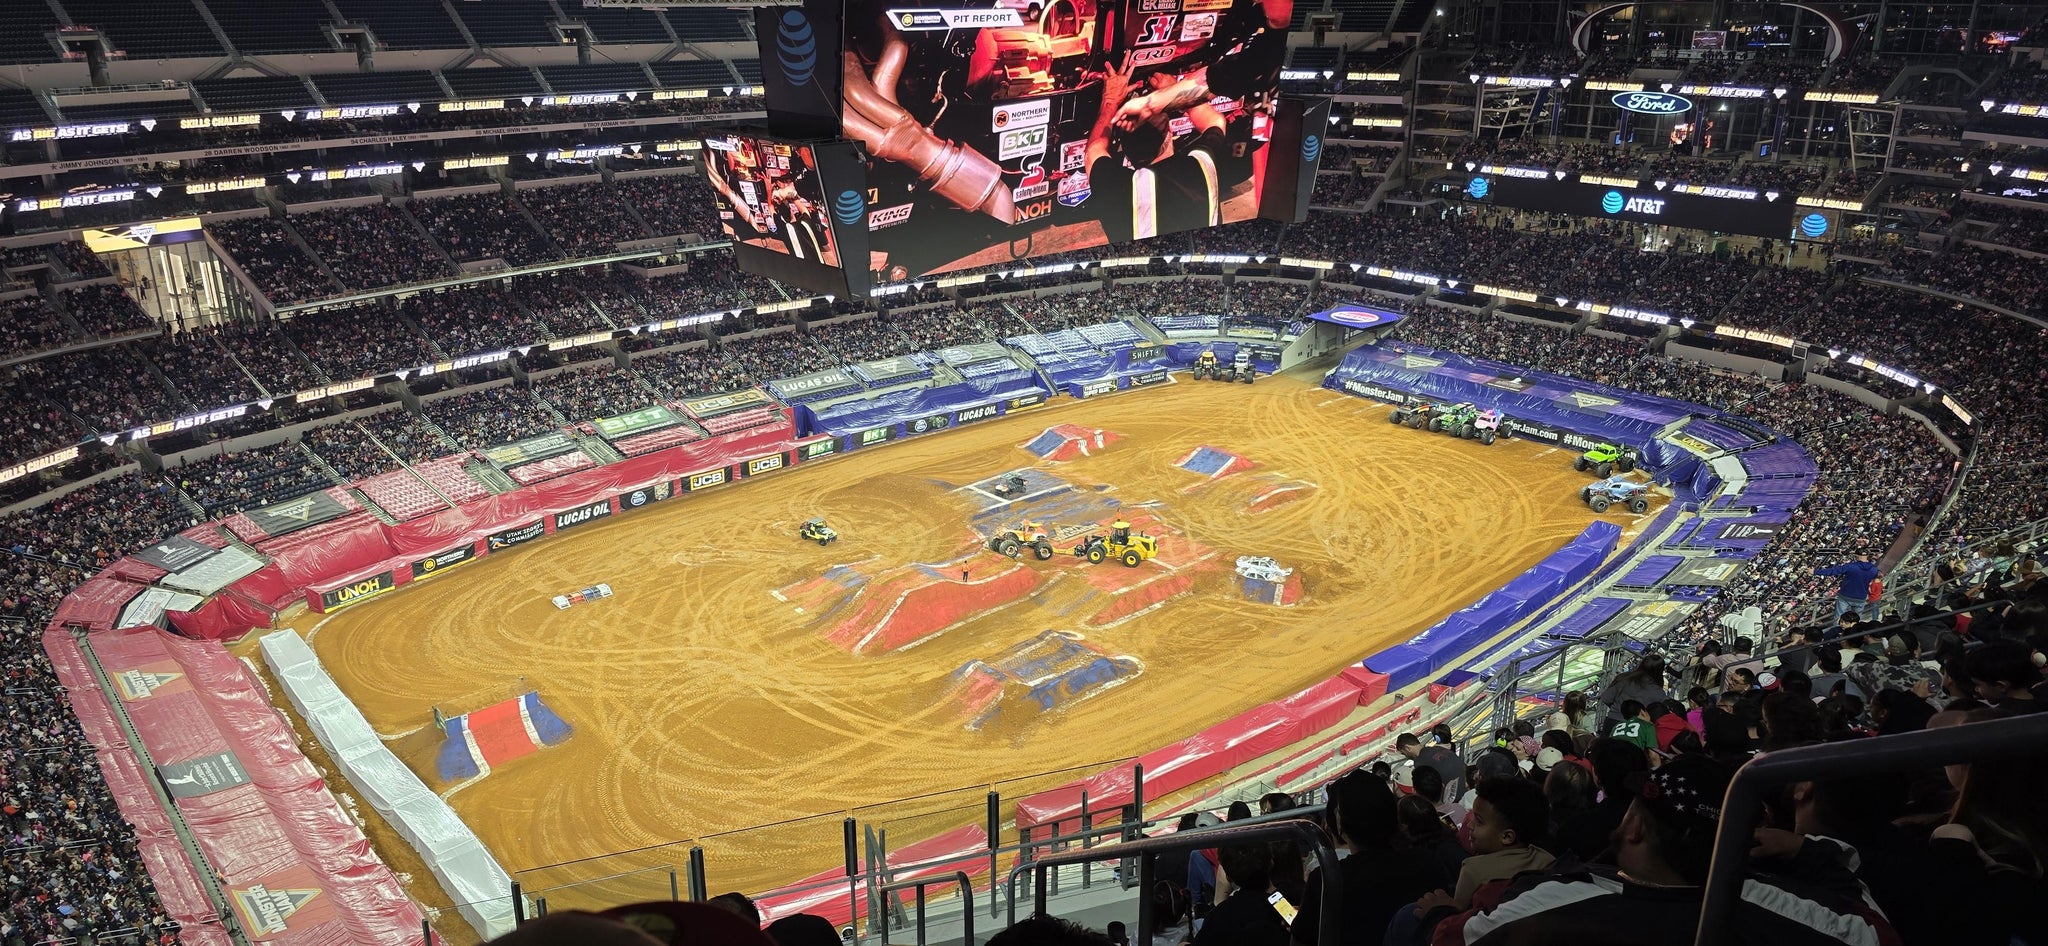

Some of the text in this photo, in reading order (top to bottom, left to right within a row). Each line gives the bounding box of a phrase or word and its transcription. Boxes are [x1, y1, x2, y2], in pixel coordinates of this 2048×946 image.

[954, 13, 1012, 23] PIT REPORT
[1134, 48, 1173, 61] CRD
[1585, 81, 1643, 91] SKILLS CHALLENGE
[1680, 85, 1764, 97] AS BIG AS IT GETS!
[541, 93, 620, 106] AS BIG AS IT GETS!
[653, 89, 709, 100] SKILLS CHALLENGE
[1628, 93, 1675, 111] Ford
[1804, 92, 1879, 104] SKILLS CHALLENGE
[306, 105, 400, 119] AS BIG AS IT GETS!
[439, 100, 505, 112] SKILLS CHALLENGE
[1012, 107, 1049, 118] NORTHERN
[2002, 104, 2038, 116] AS BIG
[181, 115, 261, 129] SKILLS CHALLENGE
[1353, 119, 1372, 127] SKILLS
[13, 123, 130, 142] AS BIG AS IT GETS!
[360, 136, 388, 145] CHARLES
[387, 134, 407, 143] HALEY
[483, 128, 507, 136] MICHAEL
[1003, 128, 1047, 151] BKT
[214, 147, 242, 157] DARREN
[244, 144, 279, 155] WOODSON
[546, 147, 624, 161] AS BIG AS IT GETS!
[657, 144, 677, 153] SKILLS
[59, 157, 119, 170] JIMMY JOHNSON
[444, 157, 509, 170] SKILLS CHALLENGE
[311, 165, 404, 182] AS BIG AS IT GETS!
[1492, 167, 1549, 179] BIG AS IT GETS!
[2010, 168, 2047, 182] AS BIG
[186, 178, 266, 195] SKILLS CHALLENGE
[1580, 175, 1640, 189] SKILLS CHALLENGE
[1015, 185, 1047, 199] safety-kleen
[1068, 190, 1091, 200] PRODUCTS
[1673, 184, 1757, 200] AS BIG AS IT GETS!
[20, 191, 135, 212] AS BIG AS IT GETS!
[1625, 200, 1665, 216] AT&T
[1796, 197, 1823, 207] SKILLS
[872, 207, 910, 224] KING
[1366, 266, 1440, 286] AS BIG AS IT GETS!
[1473, 285, 1537, 303] SKILLS CHALLENGE
[1576, 302, 1670, 325] AS BIG AS IT GETS!
[649, 313, 724, 333] AS BIG AS IT GETS!
[549, 333, 613, 352] SKILLS CHALLENGE
[715, 325, 794, 350] SKILLS CHALLENGE
[1132, 351, 1154, 361] SHIFT
[420, 352, 511, 377] AS BIG AS IT GETS!
[1847, 355, 1919, 388] AS BIG AS IT GETS!
[782, 373, 845, 392] LUCAS OIL
[297, 379, 375, 403] SKILLS CHALLENGE
[1345, 380, 1404, 403] #MonsterJam
[958, 406, 997, 422] LUCAS OIL
[132, 406, 247, 441] AS BIG AS IT GETS!
[863, 428, 888, 443] BKT
[809, 439, 835, 455] BKT
[27, 446, 79, 474] CHALLENGE
[752, 458, 781, 473] JCB
[694, 473, 723, 487] JCB
[268, 500, 316, 518] MONSTER
[286, 507, 311, 519] JAM
[558, 502, 612, 527] LUCAS OIL
[523, 521, 544, 534] SPORTS
[508, 528, 544, 543] COMMISSION
[436, 550, 466, 564] NORTHERN
[338, 577, 380, 602] UNOH
[125, 669, 152, 698] MONSTER
[1613, 722, 1641, 738] 23
[248, 883, 288, 934] MONSTER
[270, 890, 297, 917] JAM
